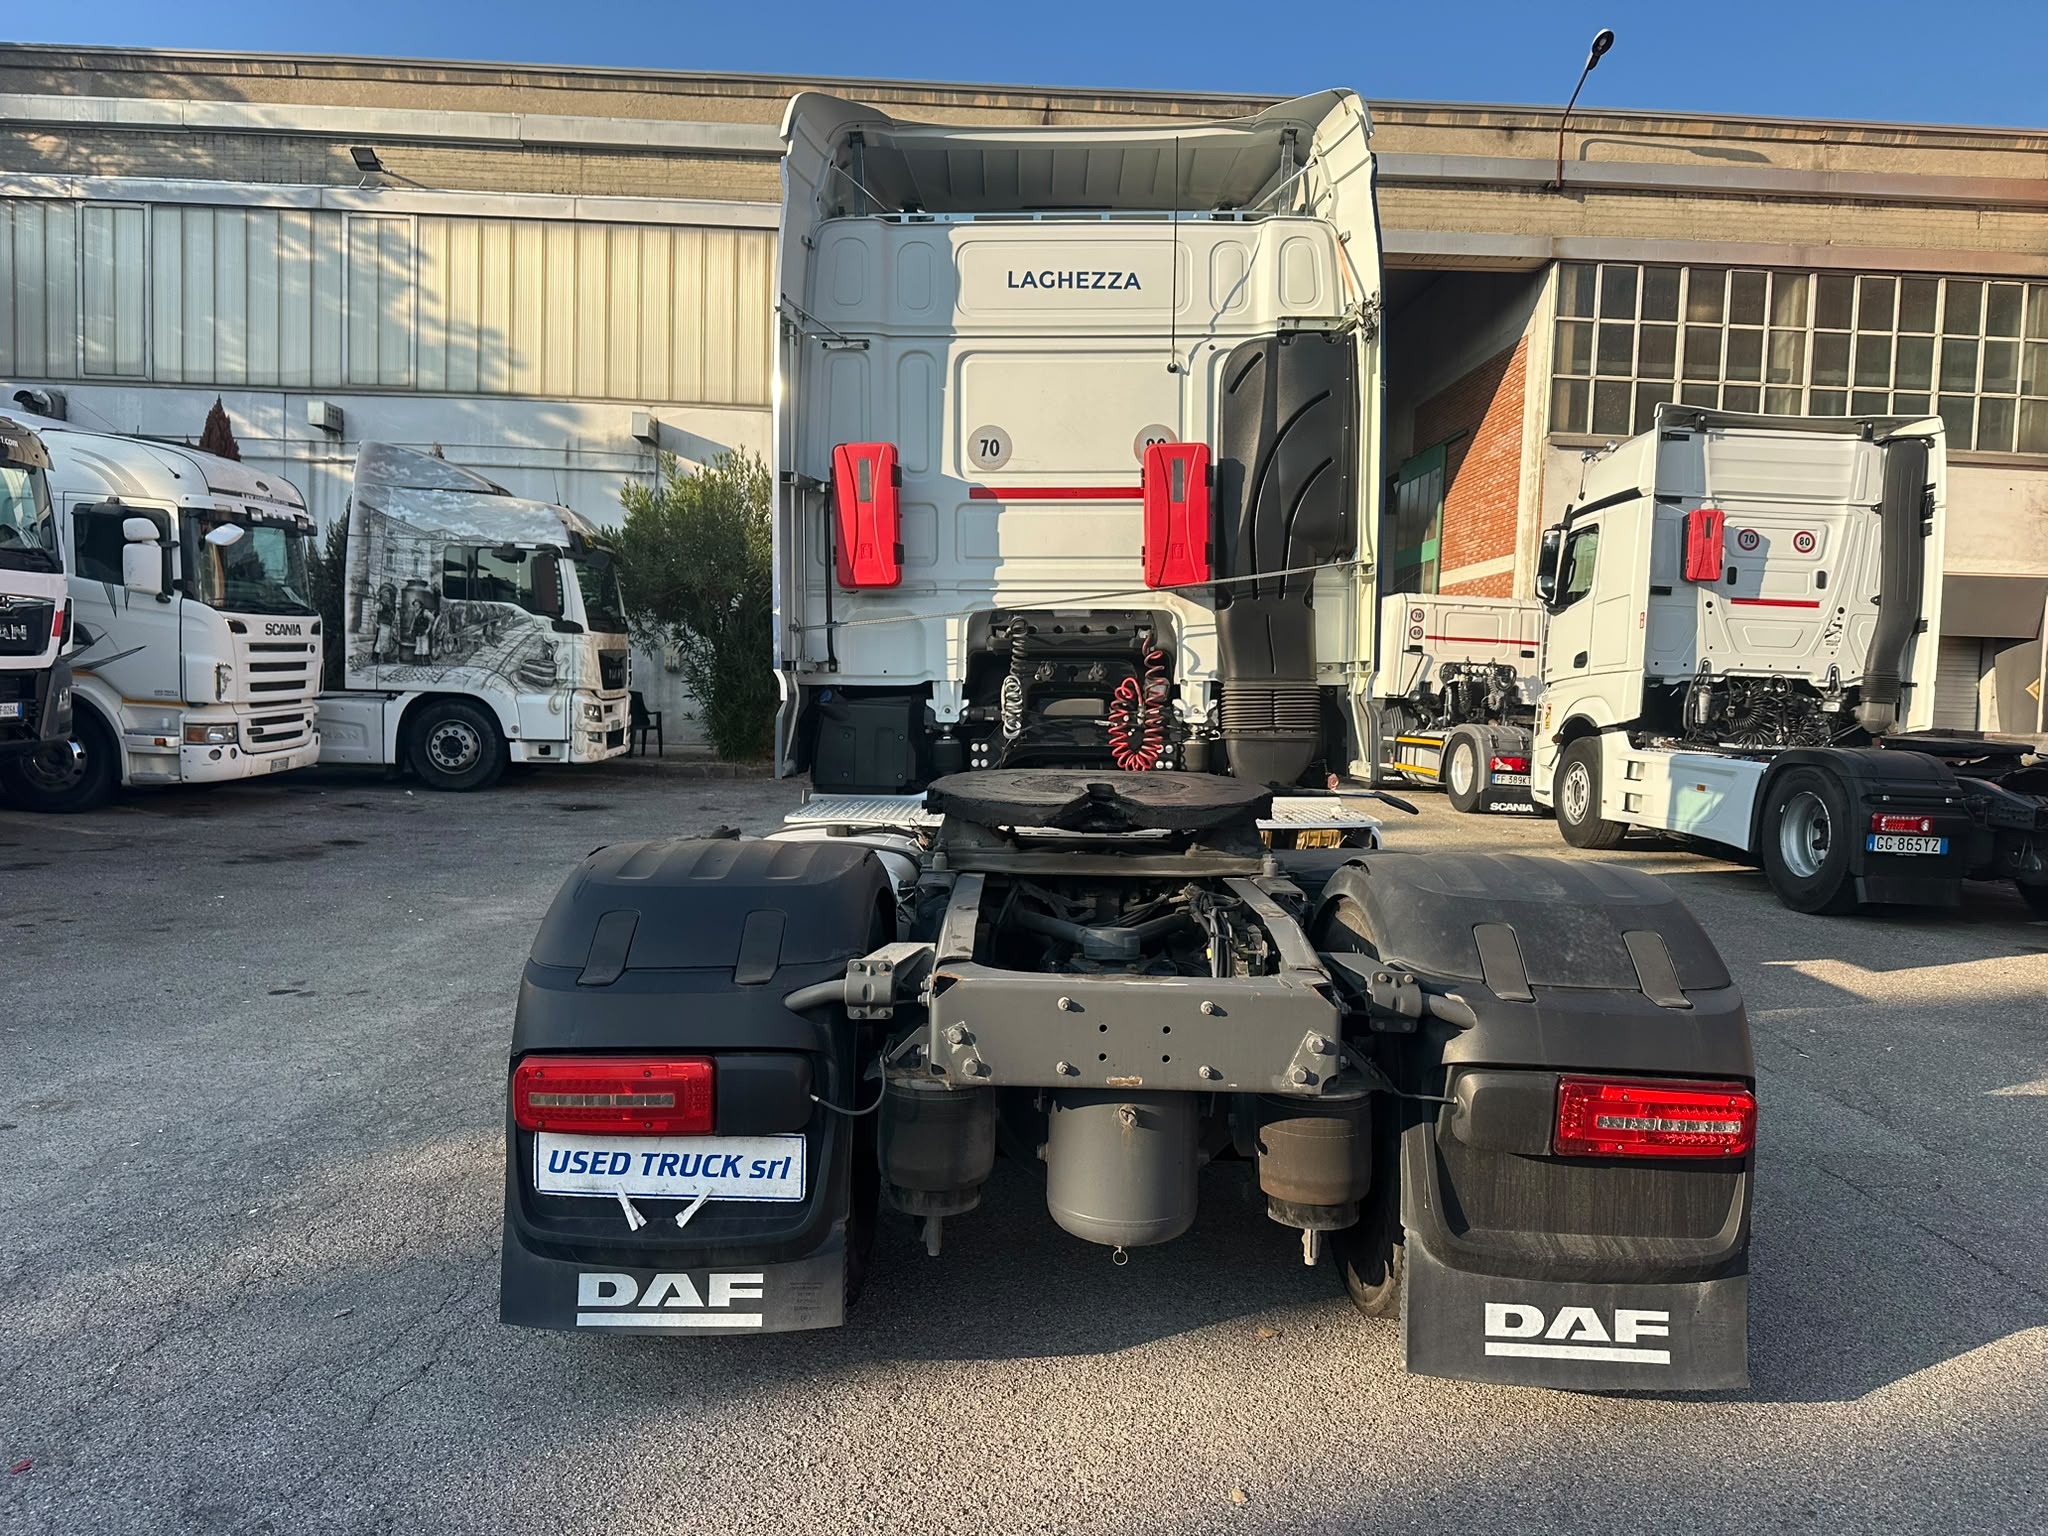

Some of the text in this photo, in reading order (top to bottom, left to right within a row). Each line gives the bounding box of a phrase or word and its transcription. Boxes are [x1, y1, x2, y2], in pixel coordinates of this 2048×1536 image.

[1007, 270, 1142, 290] LAGHEZZA
[980, 438, 1000, 457] 70
[1743, 534, 1755, 544] 70
[1798, 536, 1811, 546] 80
[265, 622, 302, 636] SCANIA
[1489, 802, 1534, 813] SCANIA
[1876, 836, 1940, 852] GG 865YZ
[548, 1150, 792, 1180] USED TRUCK srl
[577, 1273, 764, 1308] DAF
[1485, 1302, 1670, 1344] DAF
